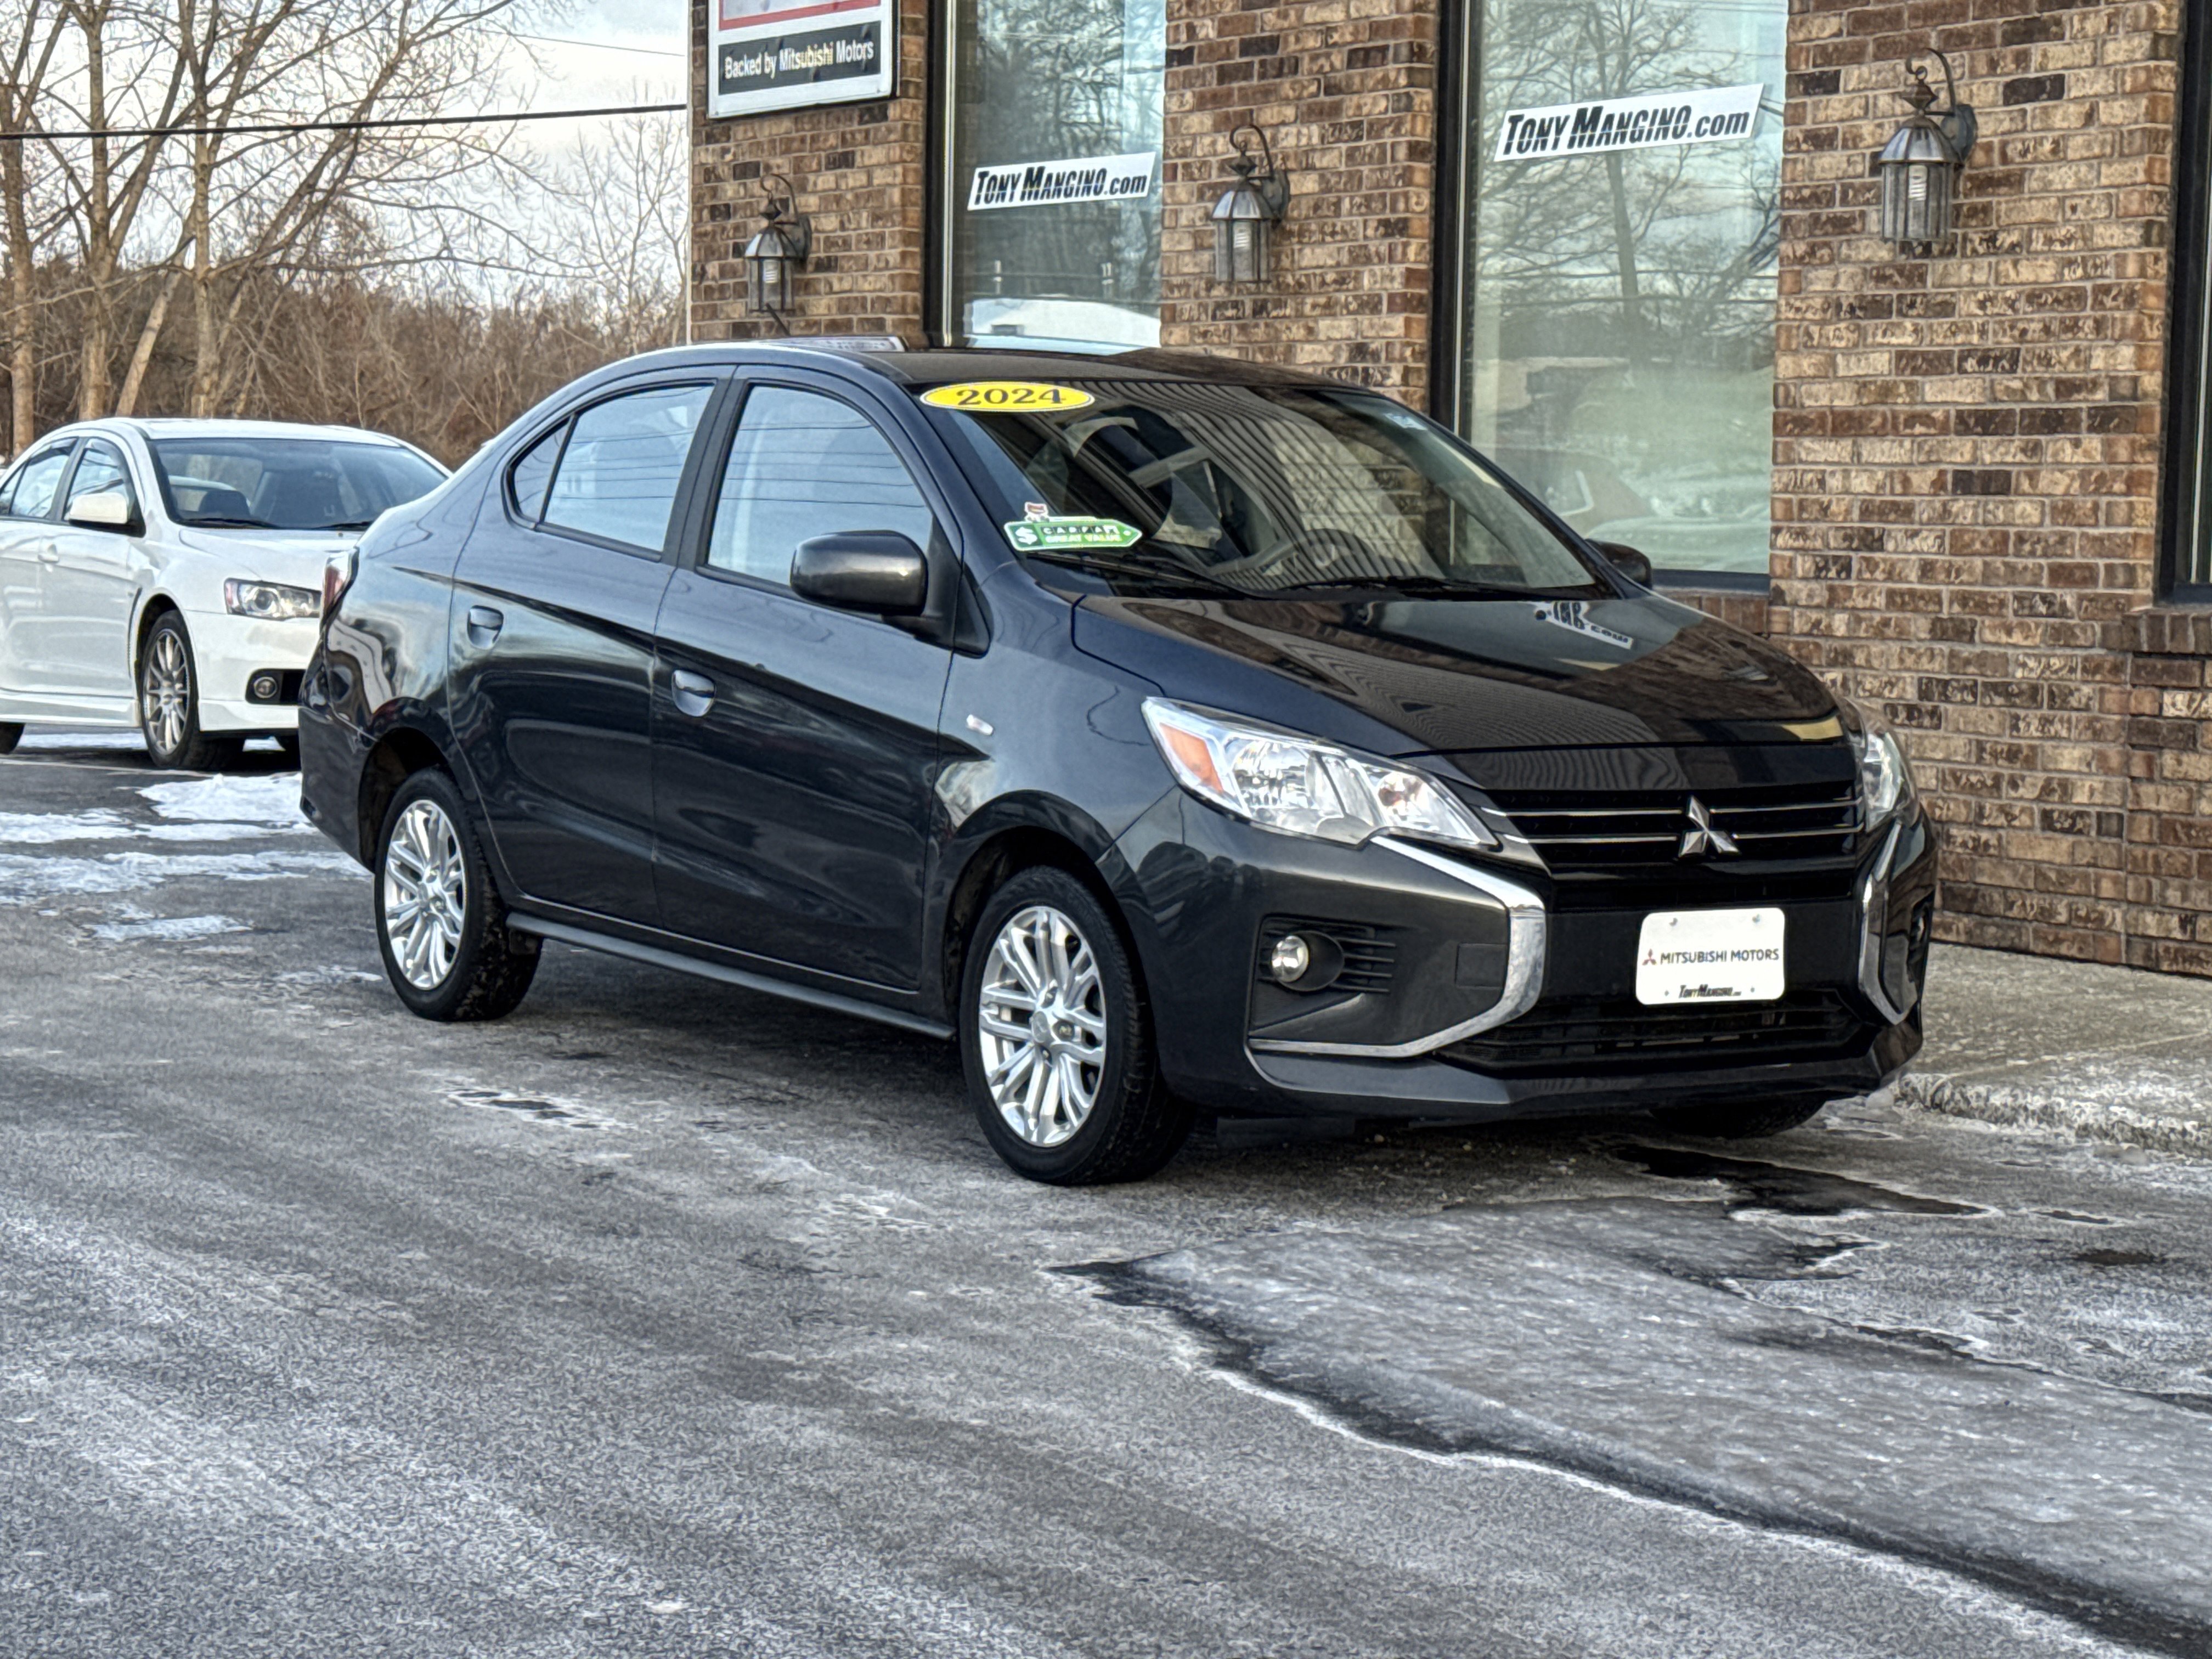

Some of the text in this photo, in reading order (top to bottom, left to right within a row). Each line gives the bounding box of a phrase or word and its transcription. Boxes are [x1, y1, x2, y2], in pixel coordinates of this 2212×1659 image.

[725, 40, 874, 79] Backed by Mitsubishi Motors
[1503, 105, 1750, 155] TONY MANGINO.com
[974, 166, 1148, 205] TONY MANGINO.com
[956, 388, 1065, 405] 2024
[1661, 948, 1779, 964] MITSUBISHI MOTORS
